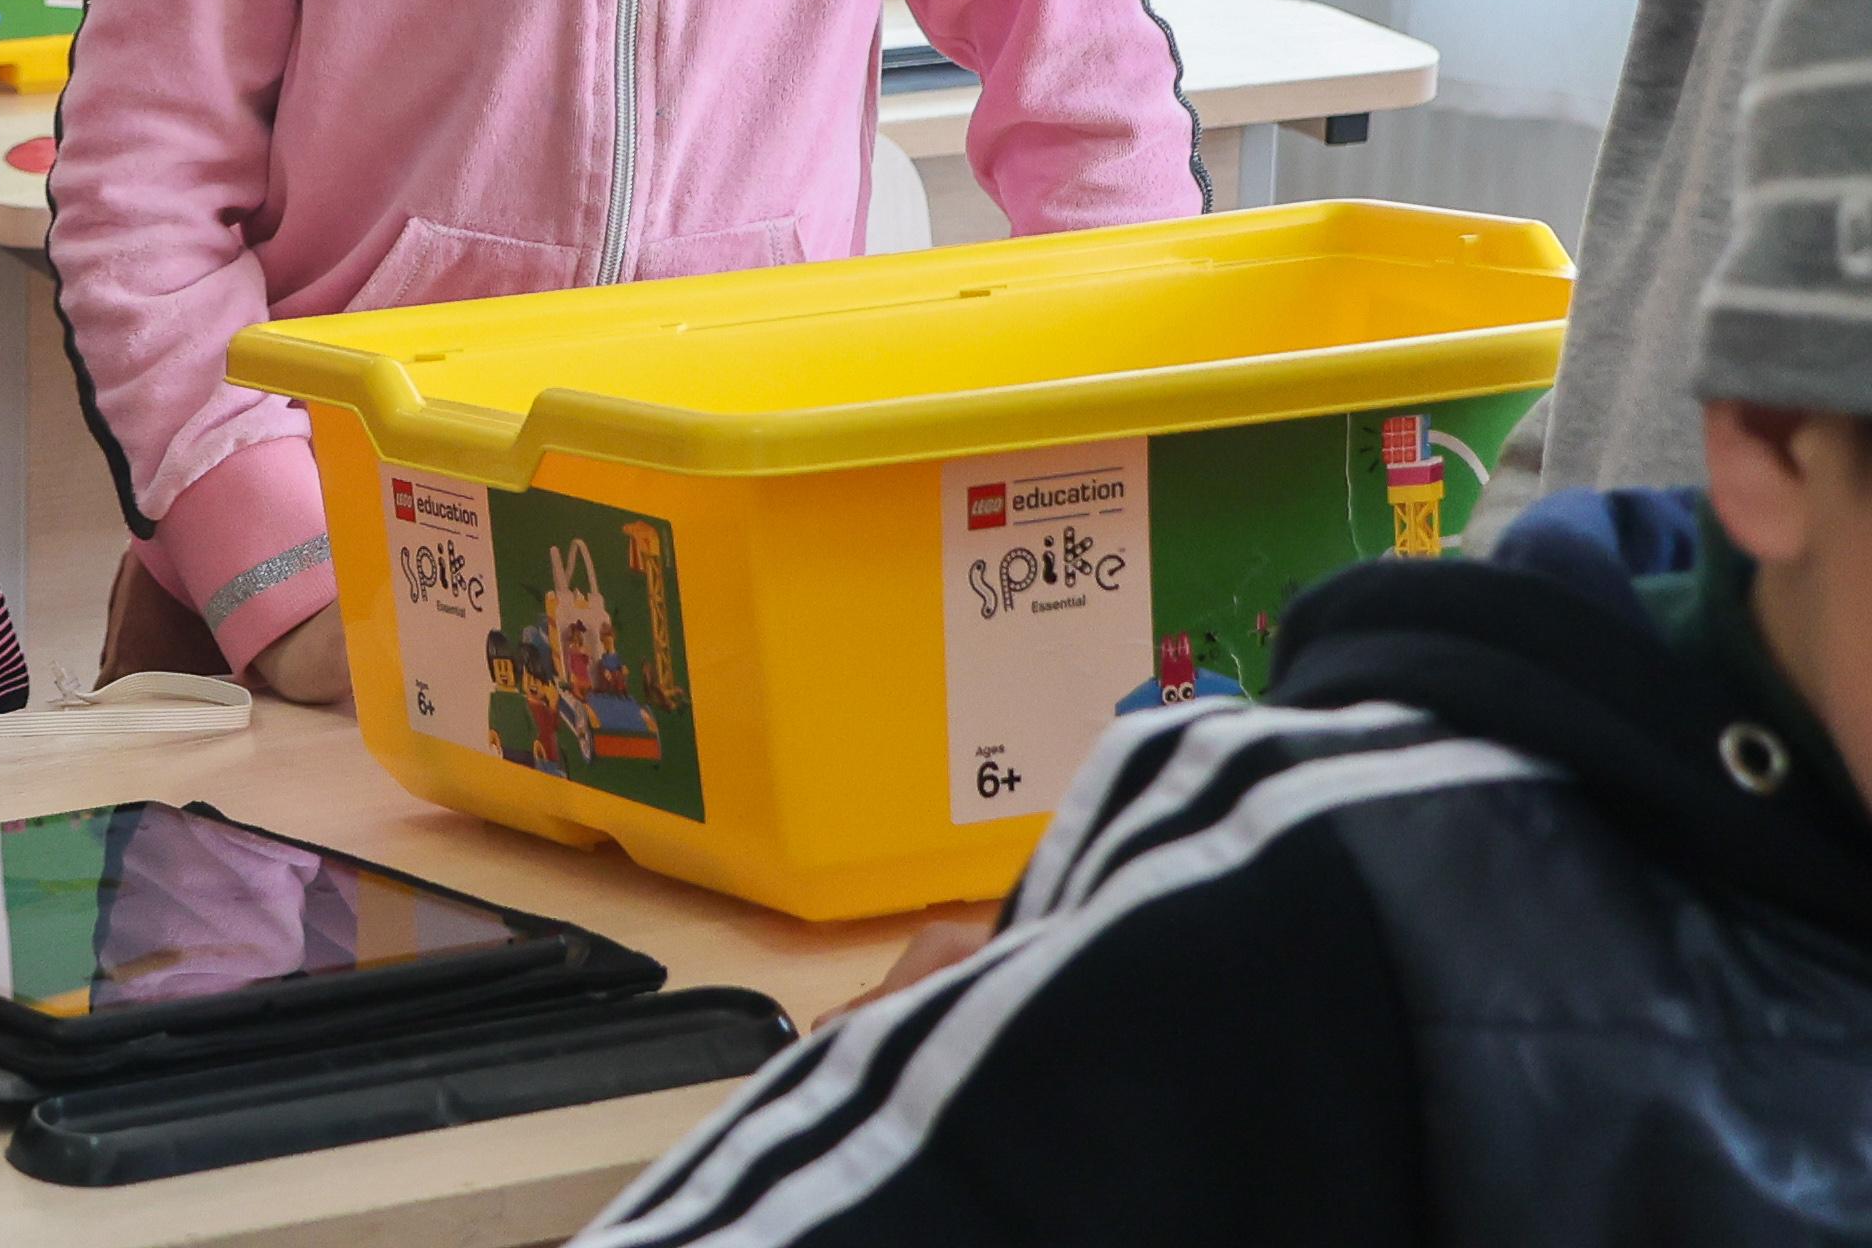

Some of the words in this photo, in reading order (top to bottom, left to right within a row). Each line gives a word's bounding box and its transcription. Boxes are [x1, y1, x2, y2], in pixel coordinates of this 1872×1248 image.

[1012, 479, 1124, 511] education
[416, 496, 478, 527] education
[400, 539, 484, 612] spike
[969, 526, 1126, 619] spike
[1031, 594, 1086, 614] Essential
[417, 691, 435, 716] 6+
[975, 743, 1005, 758] Ages
[977, 761, 1021, 798] 6+
